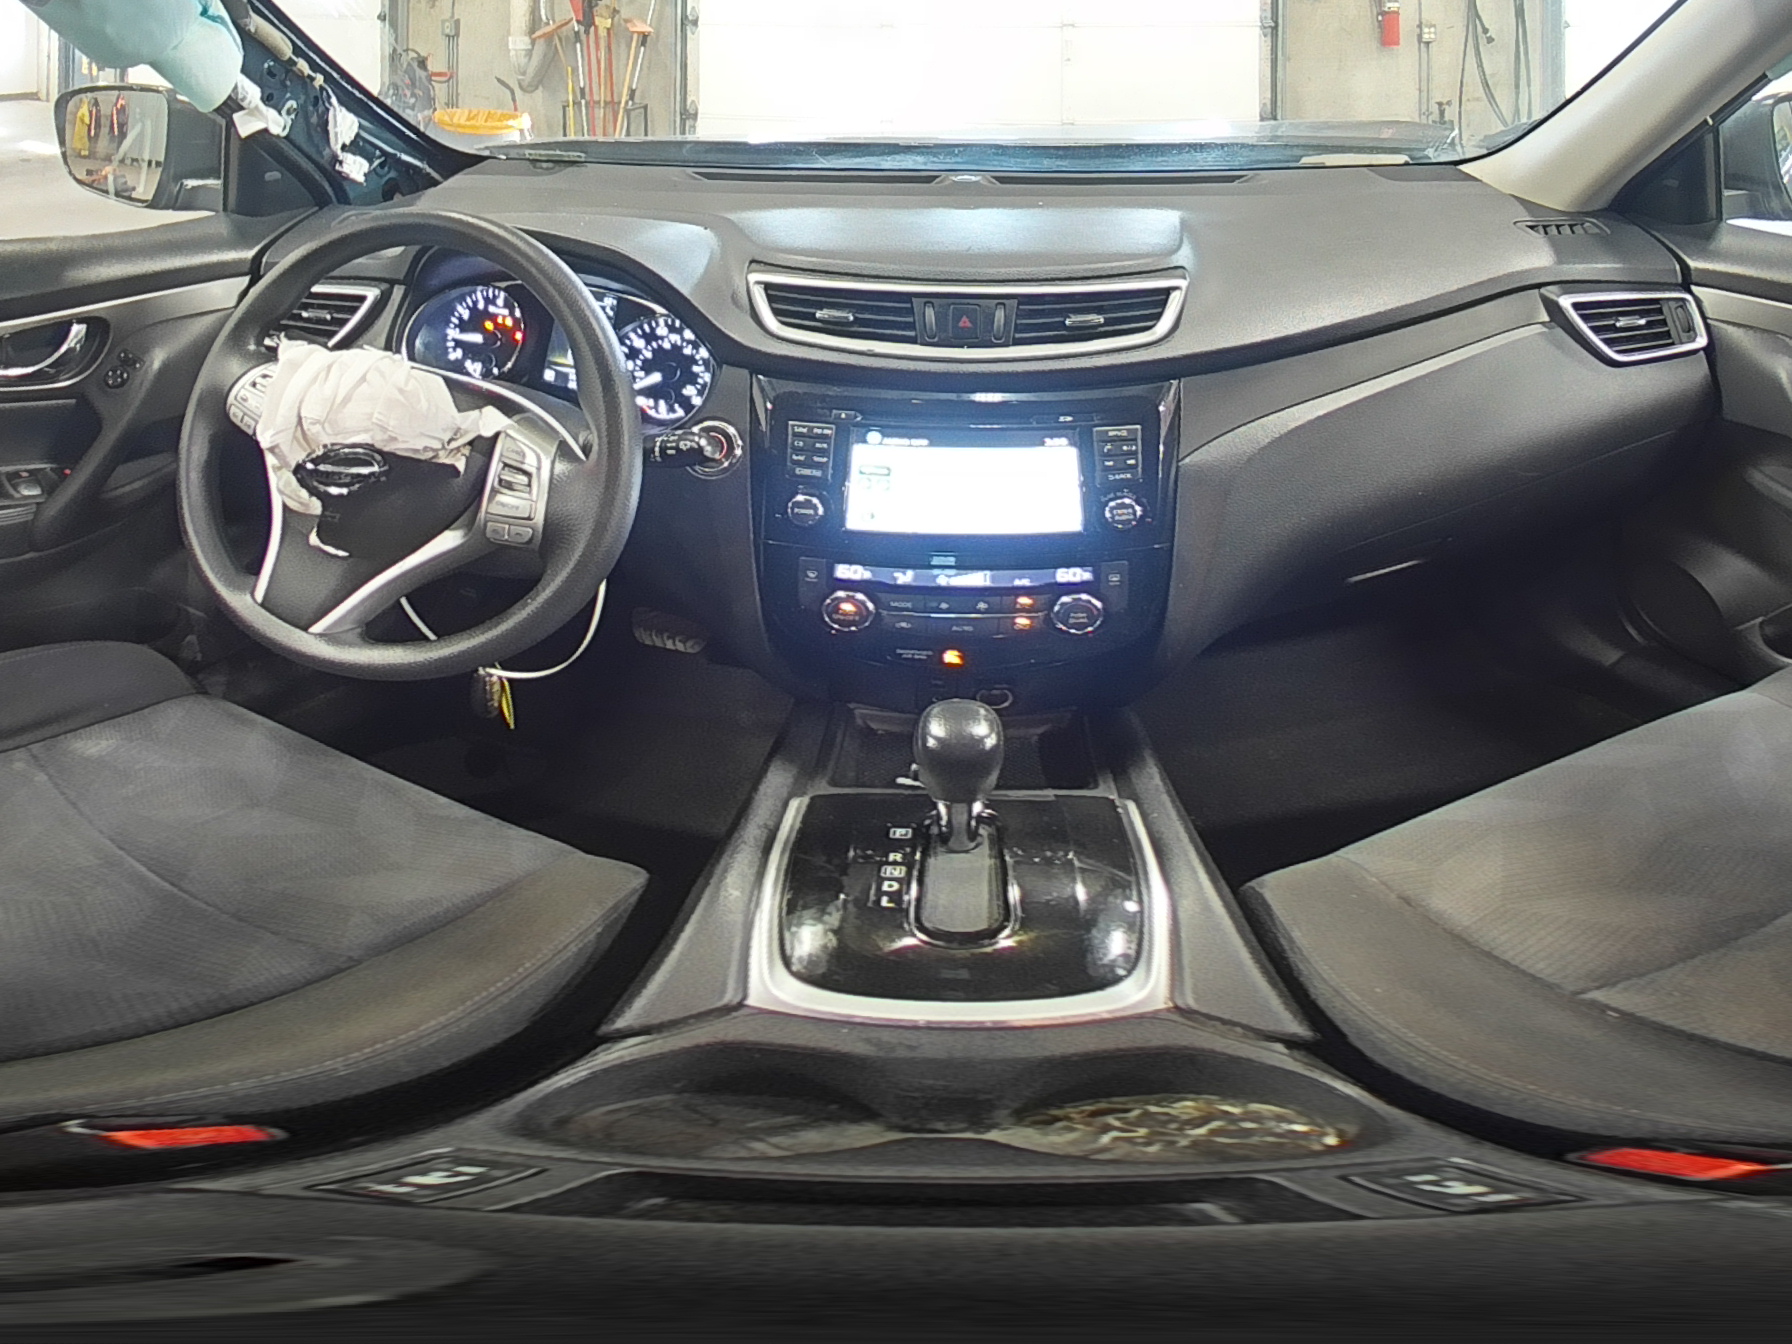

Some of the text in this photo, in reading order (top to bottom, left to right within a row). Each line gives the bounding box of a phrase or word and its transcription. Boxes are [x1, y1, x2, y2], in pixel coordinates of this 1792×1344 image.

[888, 852, 904, 863] R
[881, 880, 900, 892] D
[880, 896, 895, 907] L
